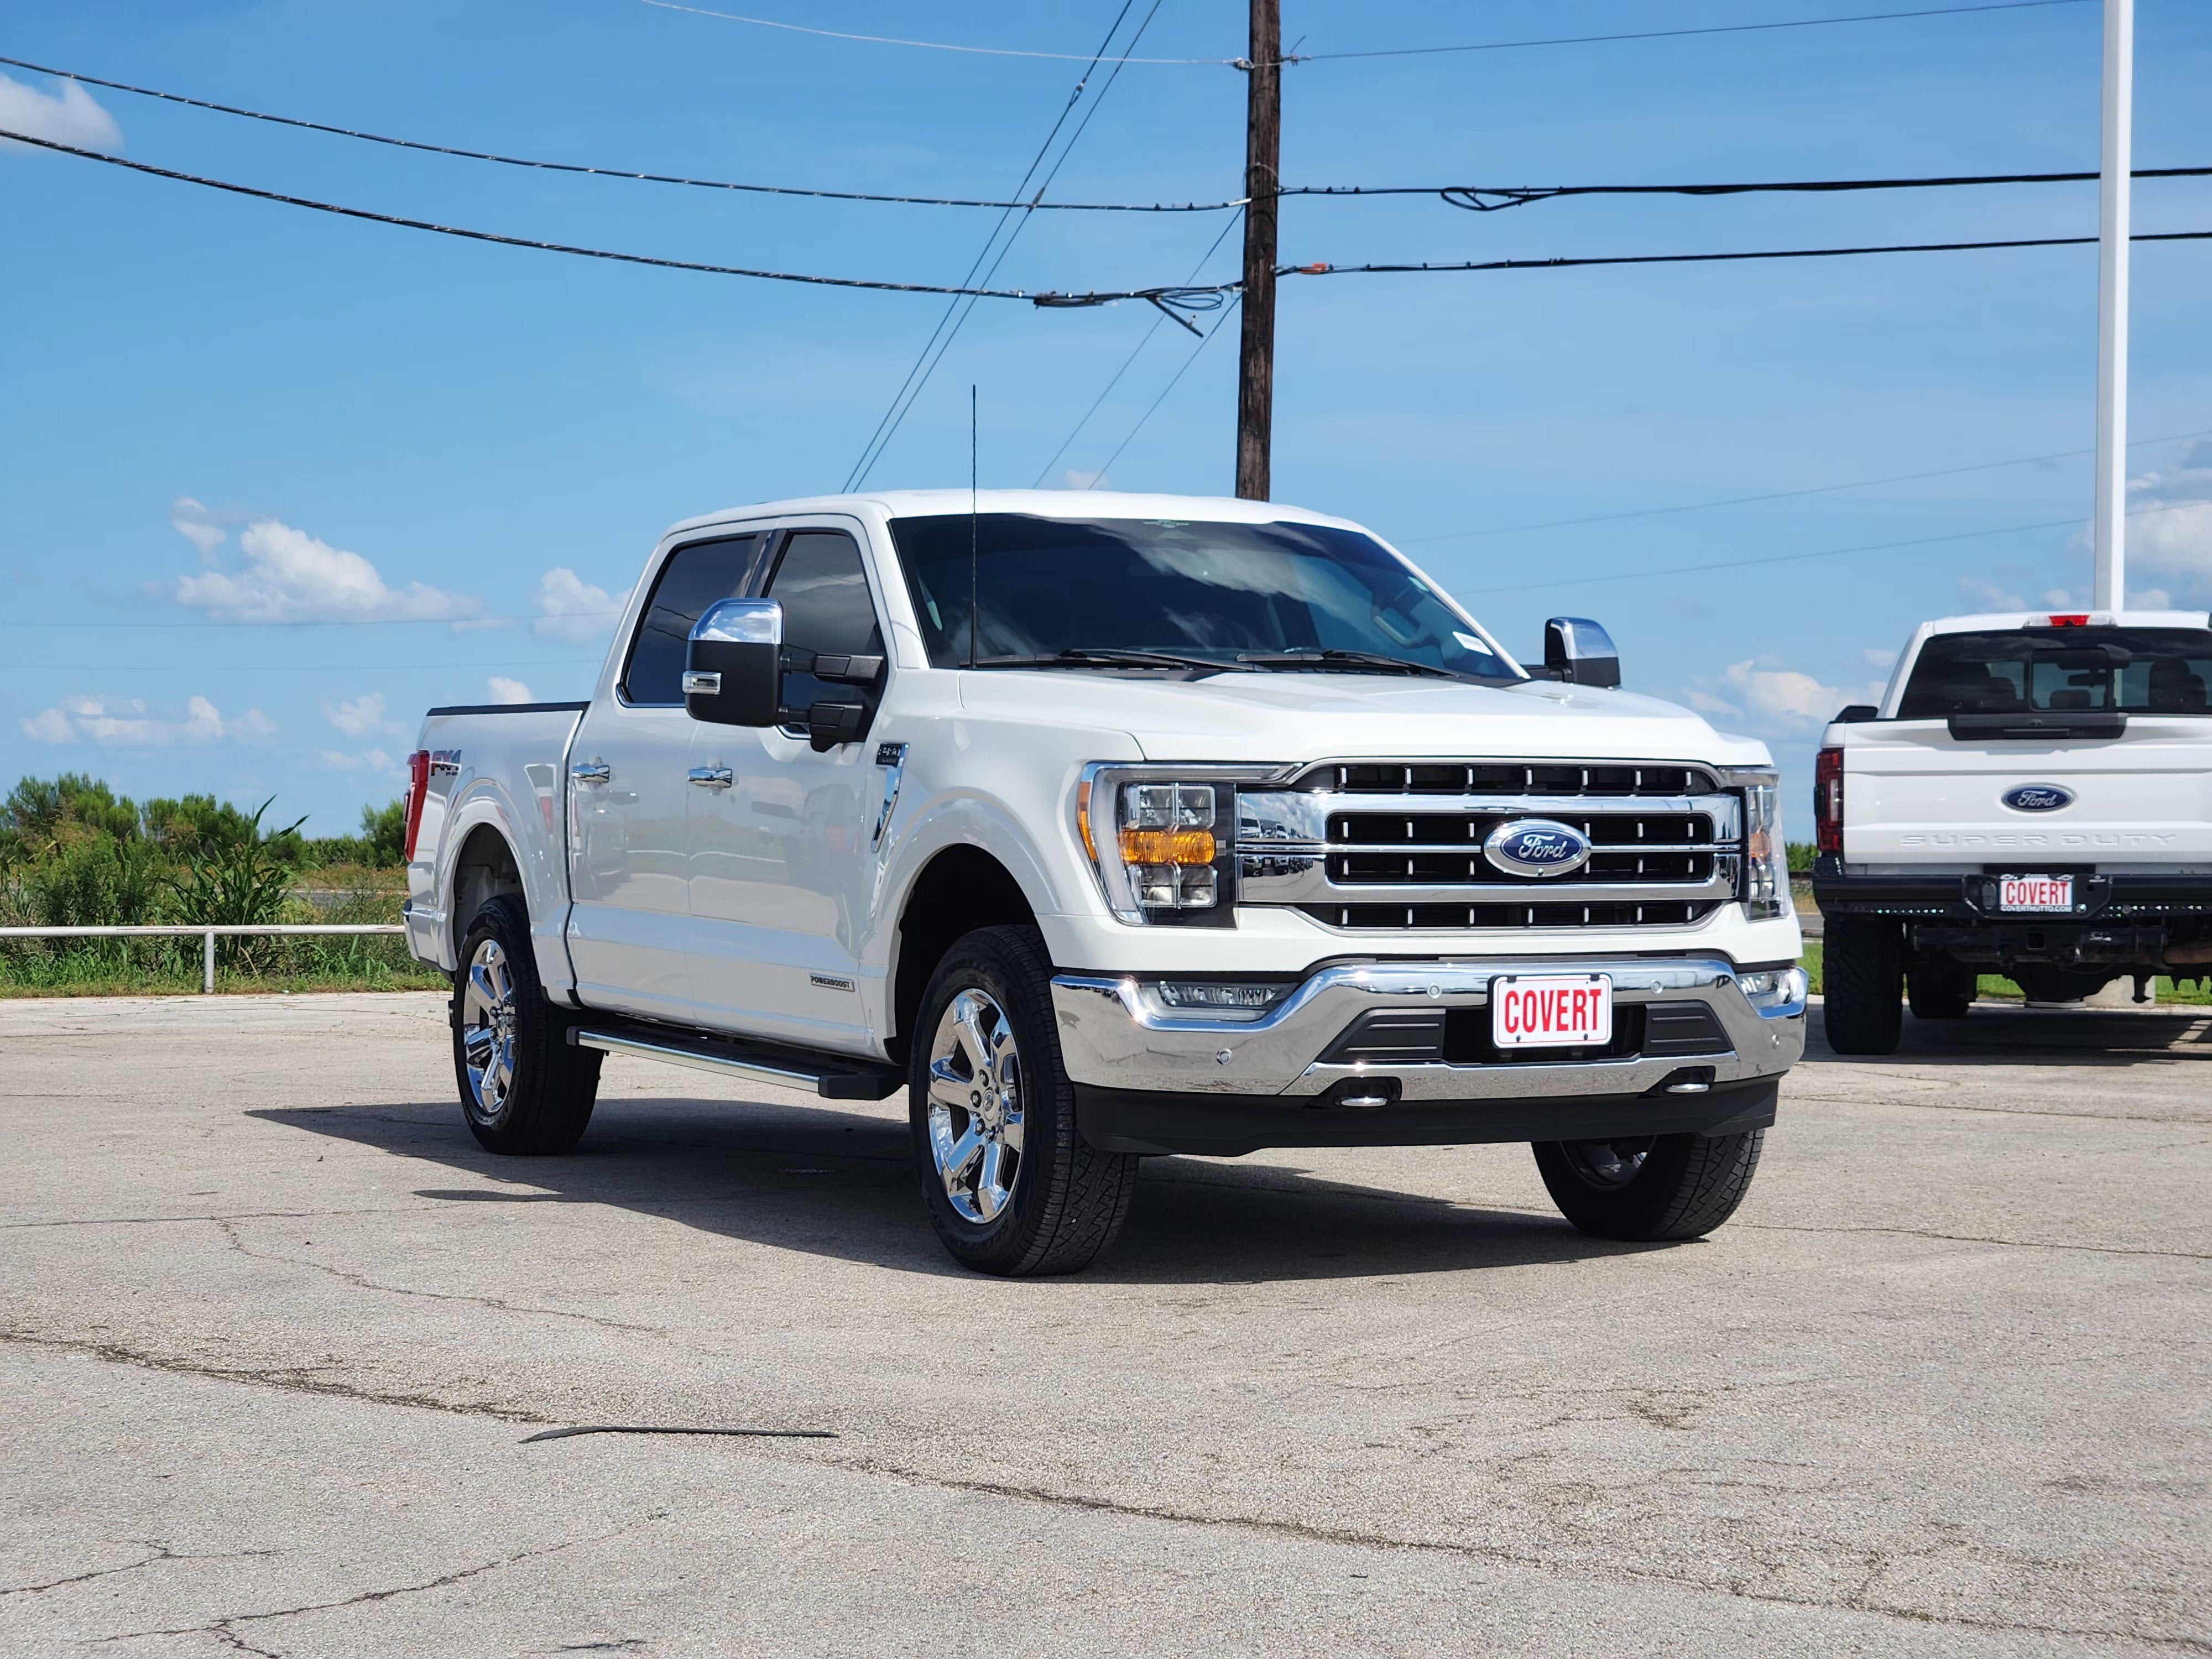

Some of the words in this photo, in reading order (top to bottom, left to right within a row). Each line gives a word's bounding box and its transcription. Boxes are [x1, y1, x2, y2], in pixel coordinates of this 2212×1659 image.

[2017, 790, 2058, 806] Ford
[1517, 833, 1568, 858] Ford
[1901, 834, 2048, 847] SUPER
[2062, 834, 2177, 846] DUTY
[2006, 881, 2068, 905] COVERT
[810, 975, 850, 989] POWERBOOST
[1504, 988, 1602, 1034] COVERT
